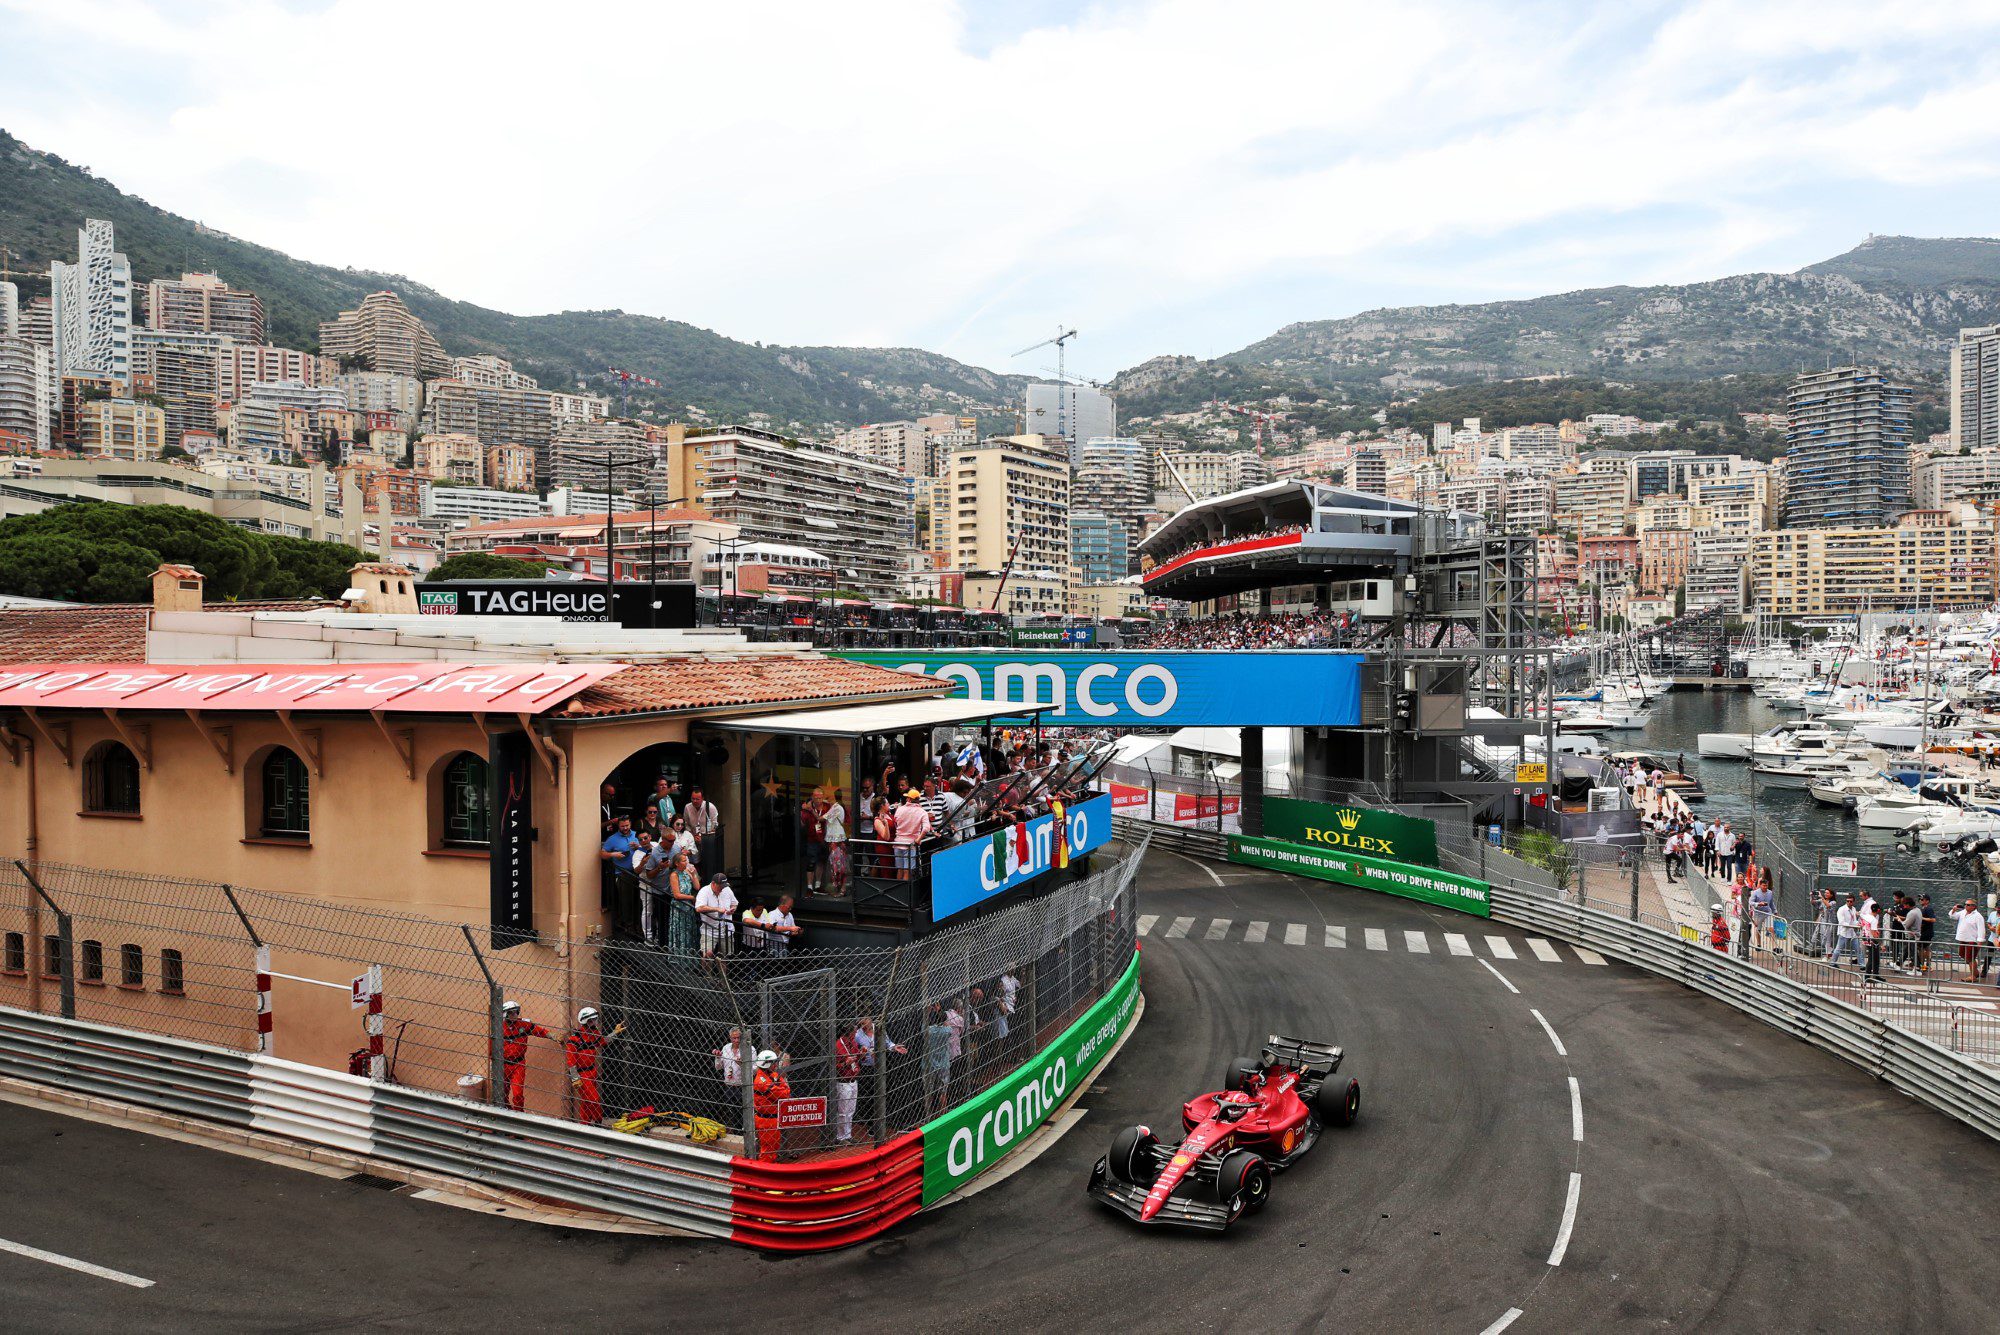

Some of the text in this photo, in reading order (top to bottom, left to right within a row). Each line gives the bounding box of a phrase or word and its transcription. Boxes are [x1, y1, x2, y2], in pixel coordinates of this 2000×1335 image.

[423, 594, 456, 604] TAG
[1018, 631, 1059, 640] Heineken
[73, 674, 170, 692] DE
[148, 672, 577, 694] MONTE-CARLO
[1518, 765, 1545, 773] PIT LANE
[1305, 827, 1395, 855] ROLEX
[511, 809, 519, 921] LA RASCASSE
[1240, 844, 1486, 901] WHEN YOU DRIVE NEVER DRINK WHEN YOU DRIVE NEVER DRINK
[947, 1056, 1066, 1177] aramco
[1076, 1035, 1096, 1067] where
[1096, 1013, 1117, 1038] energy
[787, 1103, 818, 1113] BOUCHE
[782, 1112, 823, 1123] D'INCENDIE
